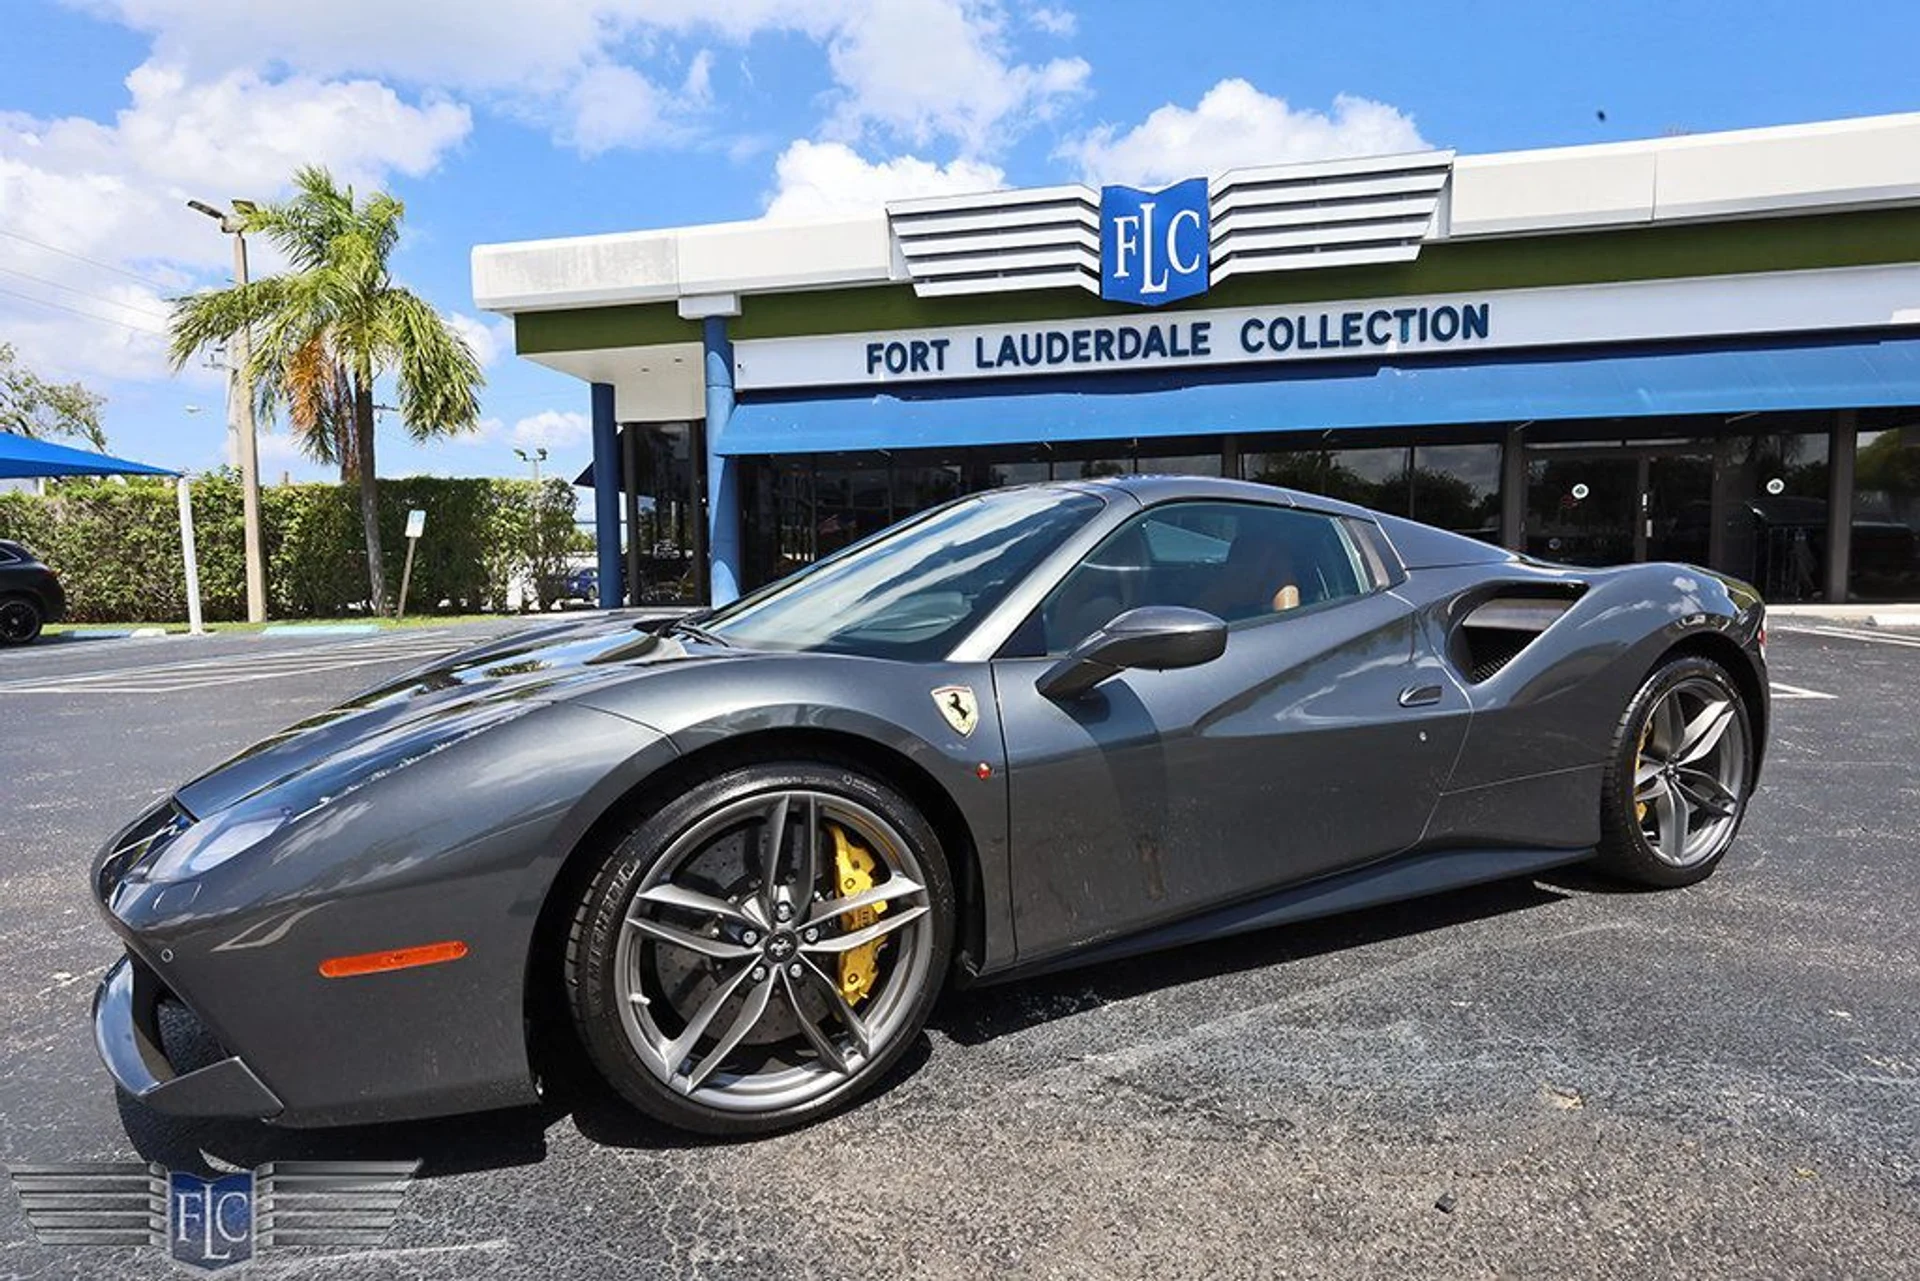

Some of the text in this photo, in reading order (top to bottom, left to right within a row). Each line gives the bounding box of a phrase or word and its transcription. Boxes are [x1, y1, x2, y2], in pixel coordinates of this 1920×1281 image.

[1113, 202, 1201, 294] FLC
[866, 303, 1489, 374] FORT LAUDERDALE COLLECTION
